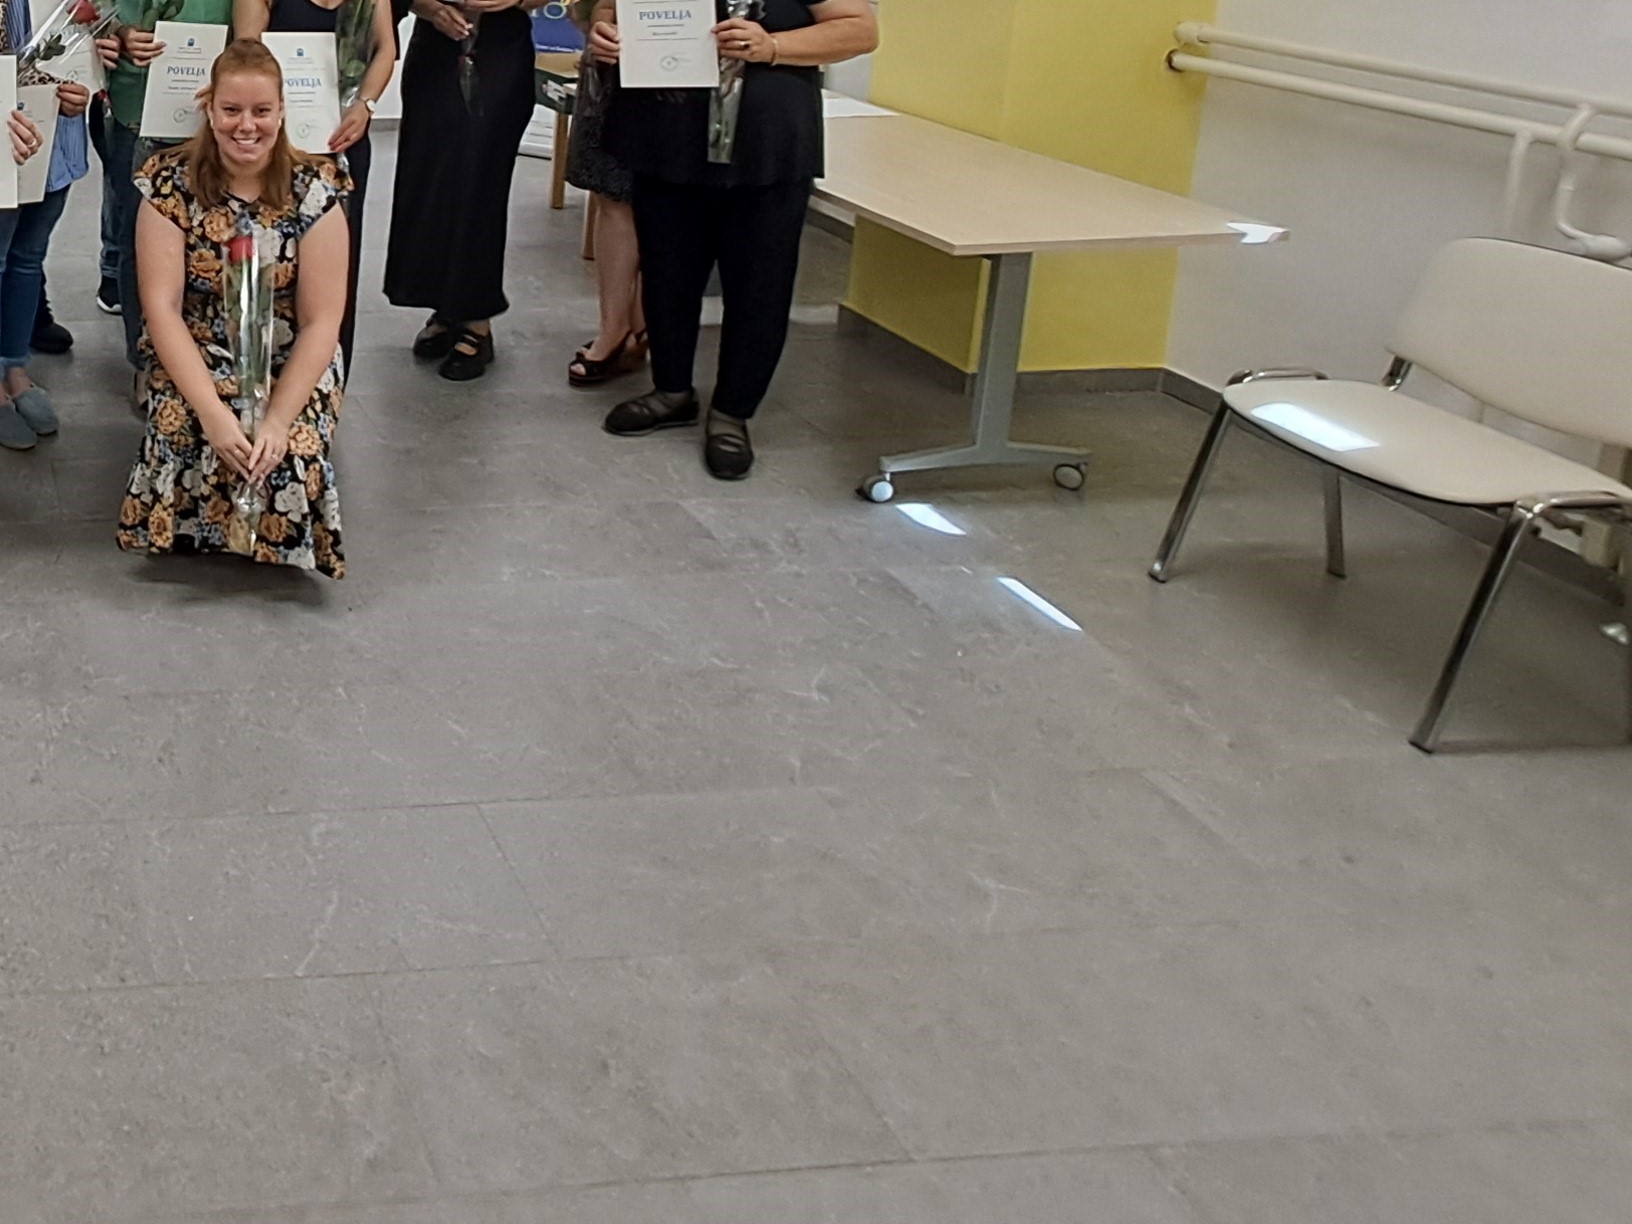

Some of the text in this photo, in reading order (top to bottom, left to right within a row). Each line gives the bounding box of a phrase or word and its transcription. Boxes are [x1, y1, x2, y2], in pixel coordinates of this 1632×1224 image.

[639, 10, 692, 21] POVELJA
[167, 65, 205, 76] POVELJA
[285, 78, 322, 88] OVELJA
